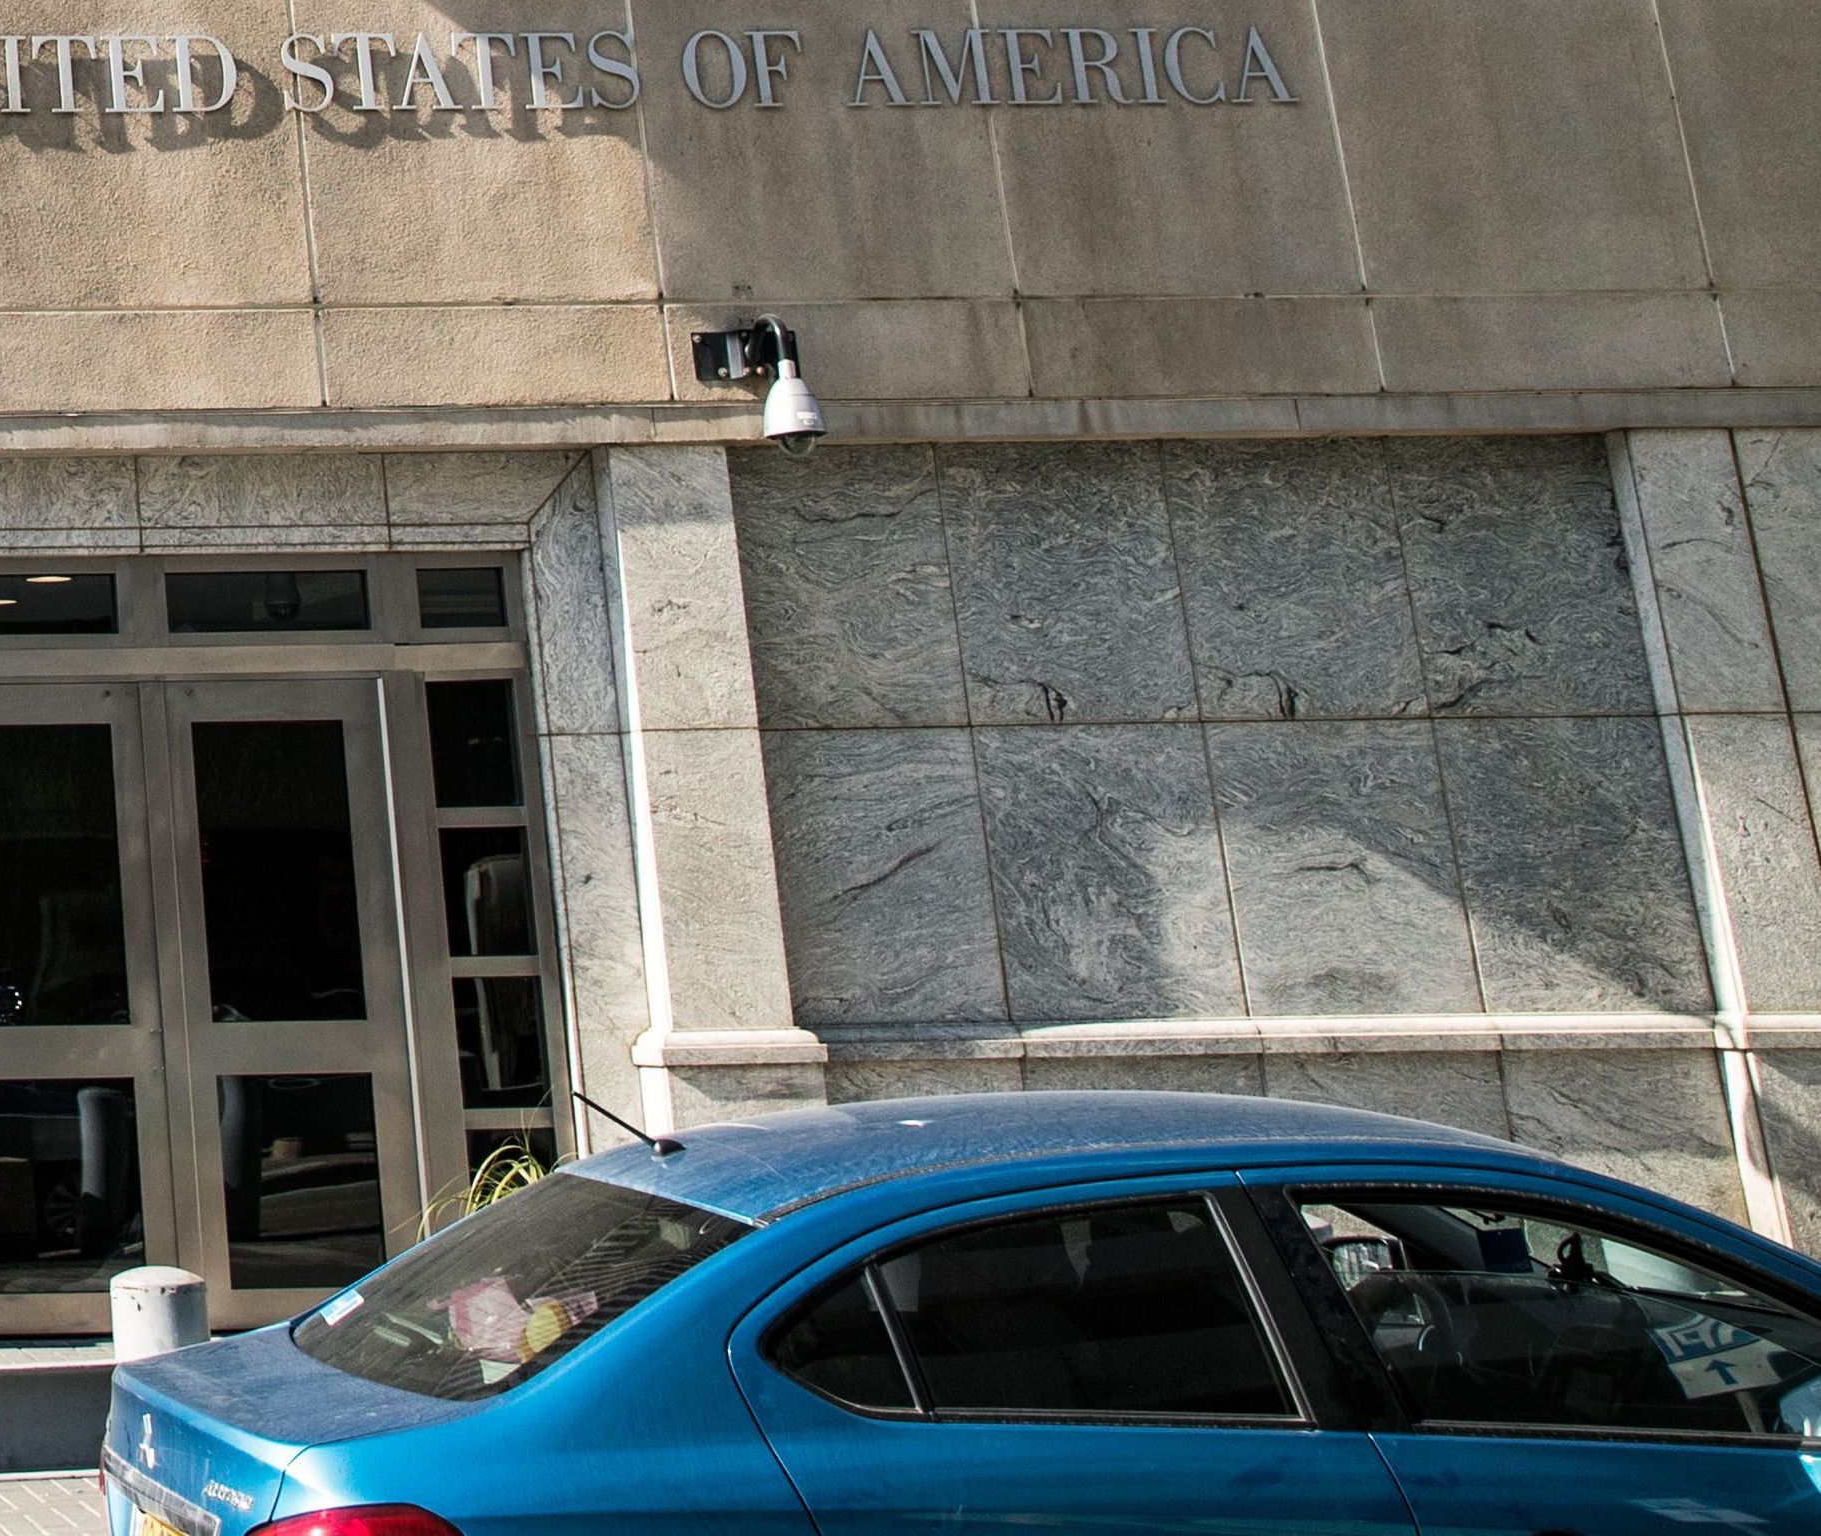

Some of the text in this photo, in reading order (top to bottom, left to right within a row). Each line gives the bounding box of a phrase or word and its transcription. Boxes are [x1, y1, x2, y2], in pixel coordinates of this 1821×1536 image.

[282, 31, 642, 112] STATES
[680, 30, 802, 109] OF
[848, 26, 1300, 107] AMERICA
